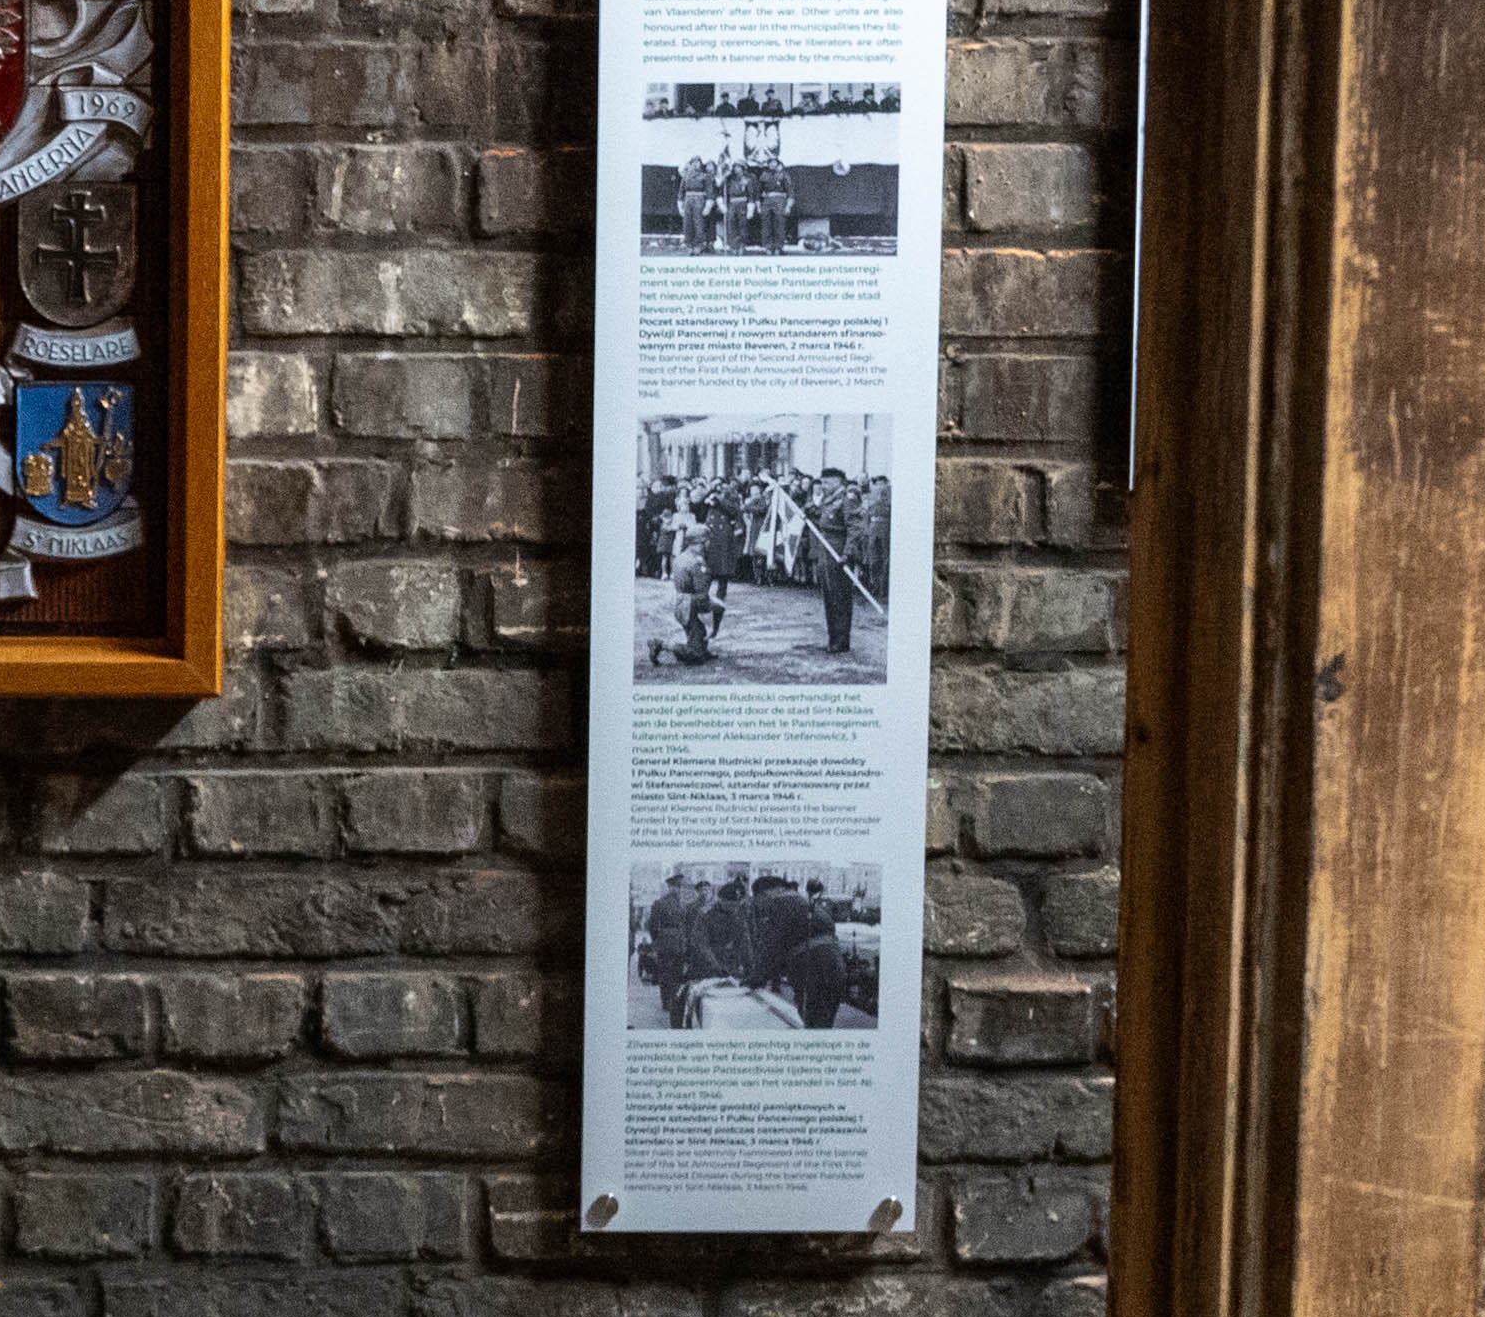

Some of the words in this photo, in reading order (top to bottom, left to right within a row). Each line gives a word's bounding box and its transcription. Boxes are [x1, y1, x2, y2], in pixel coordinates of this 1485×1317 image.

[729, 7, 751, 16] after
[756, 7, 773, 15] the
[802, 7, 830, 16] Other
[835, 8, 859, 16] units
[884, 8, 903, 16] also
[643, 23, 692, 32] honoured
[695, 23, 717, 32] after
[720, 23, 736, 31] the
[760, 23, 769, 31] in
[771, 23, 788, 31] the
[790, 22, 860, 32] municipalities
[862, 23, 884, 31] they
[682, 38, 716, 49] During
[721, 39, 780, 47] ceremonies,
[877, 38, 903, 47] often
[643, 54, 694, 63] presented
[696, 54, 718, 62] with
[729, 54, 765, 62] banner
[767, 54, 797, 62] made
[799, 54, 811, 63] by
[813, 53, 831, 62] the
[80, 94, 137, 121] 1969
[21, 335, 133, 362] ROESELARE
[48, 533, 129, 555] NIKLAAS
